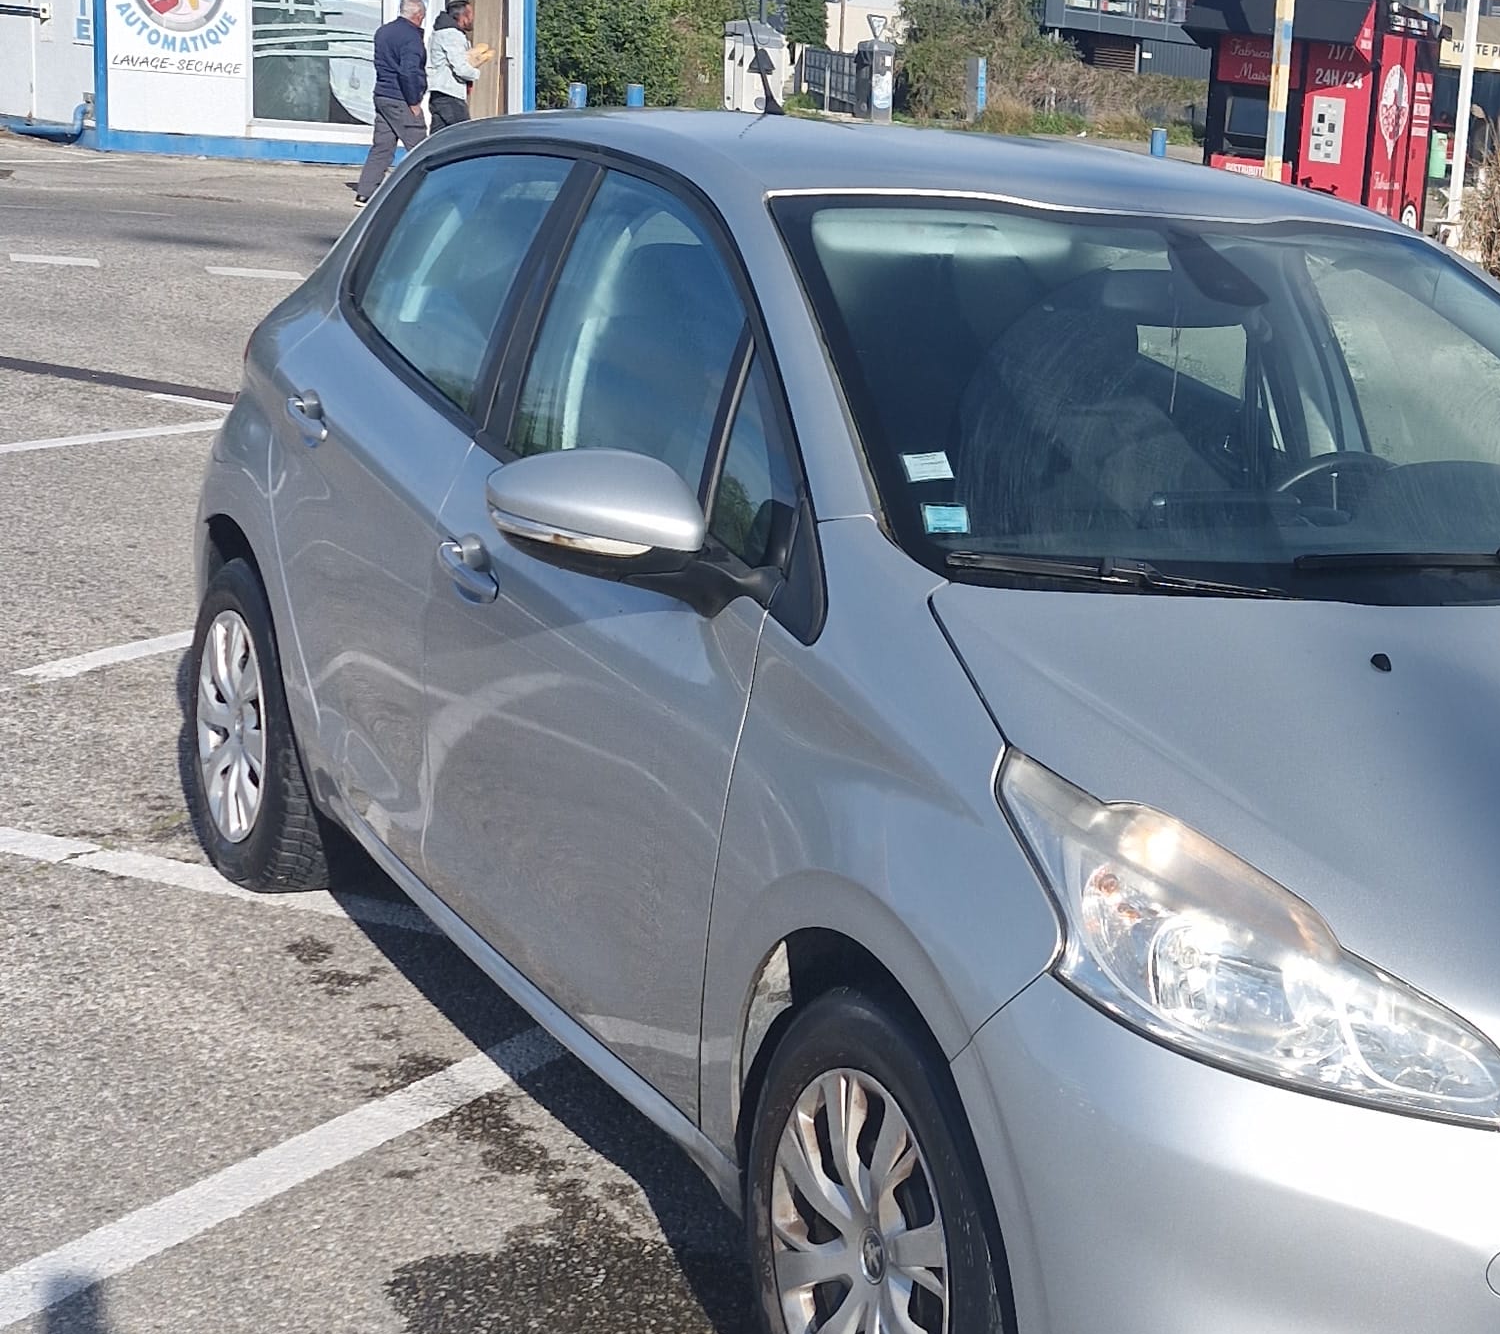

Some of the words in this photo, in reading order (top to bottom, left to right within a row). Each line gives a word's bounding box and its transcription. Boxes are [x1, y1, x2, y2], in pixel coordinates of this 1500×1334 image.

[116, 1, 237, 54] AUTOMATIQUE
[1452, 41, 1489, 56] HTE
[112, 54, 242, 75] LAVAGE-SECHAGE
[1315, 67, 1364, 90] 24H/24
